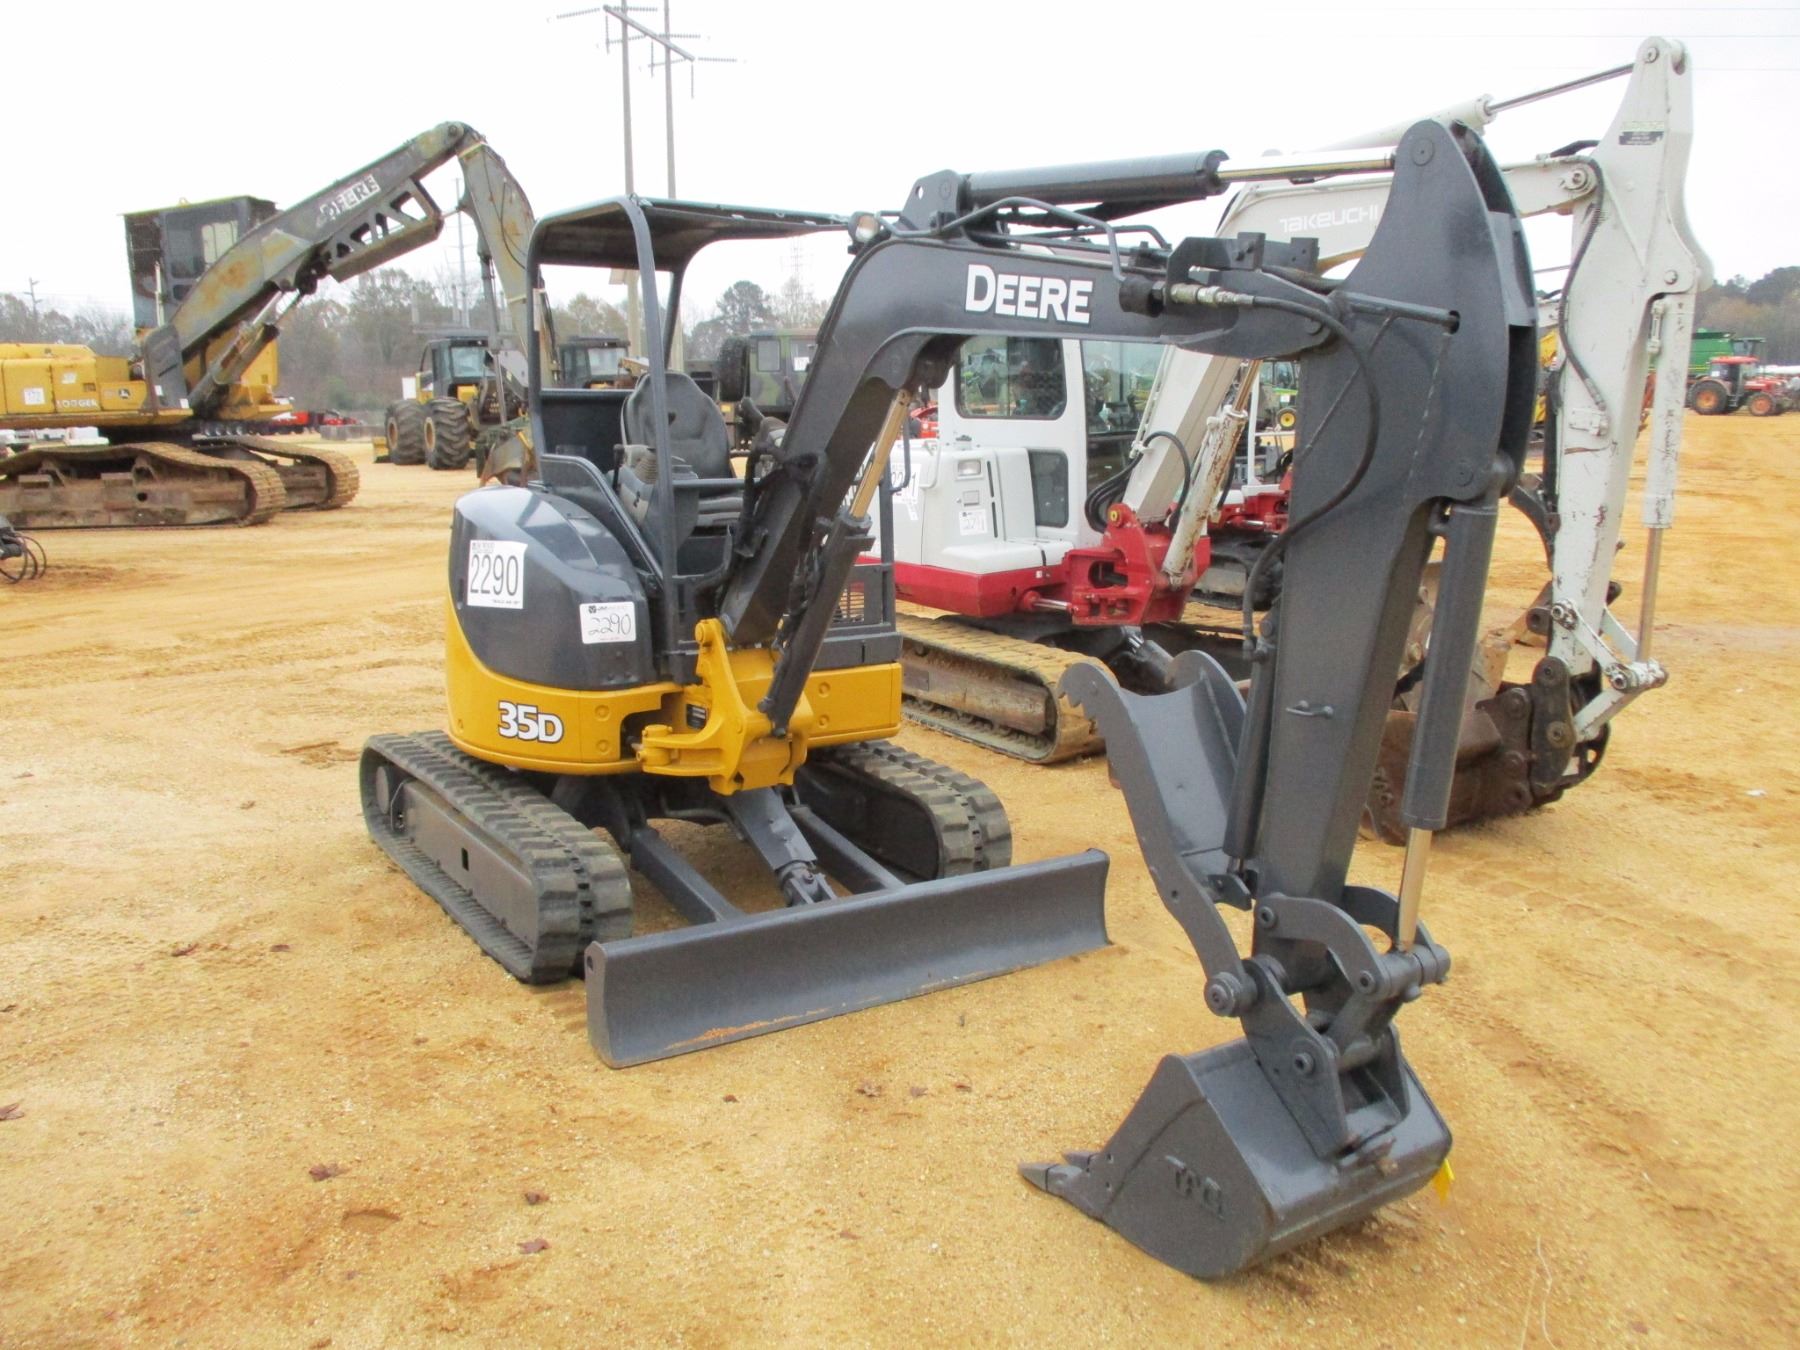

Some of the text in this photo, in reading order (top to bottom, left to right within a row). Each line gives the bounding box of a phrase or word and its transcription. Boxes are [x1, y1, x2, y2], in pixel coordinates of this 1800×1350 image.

[1280, 204, 1378, 233] TAKEUCHI
[965, 264, 1093, 324] DEERE
[470, 554, 519, 596] 2290
[588, 613, 631, 635] 2290
[498, 700, 564, 743] 35D
